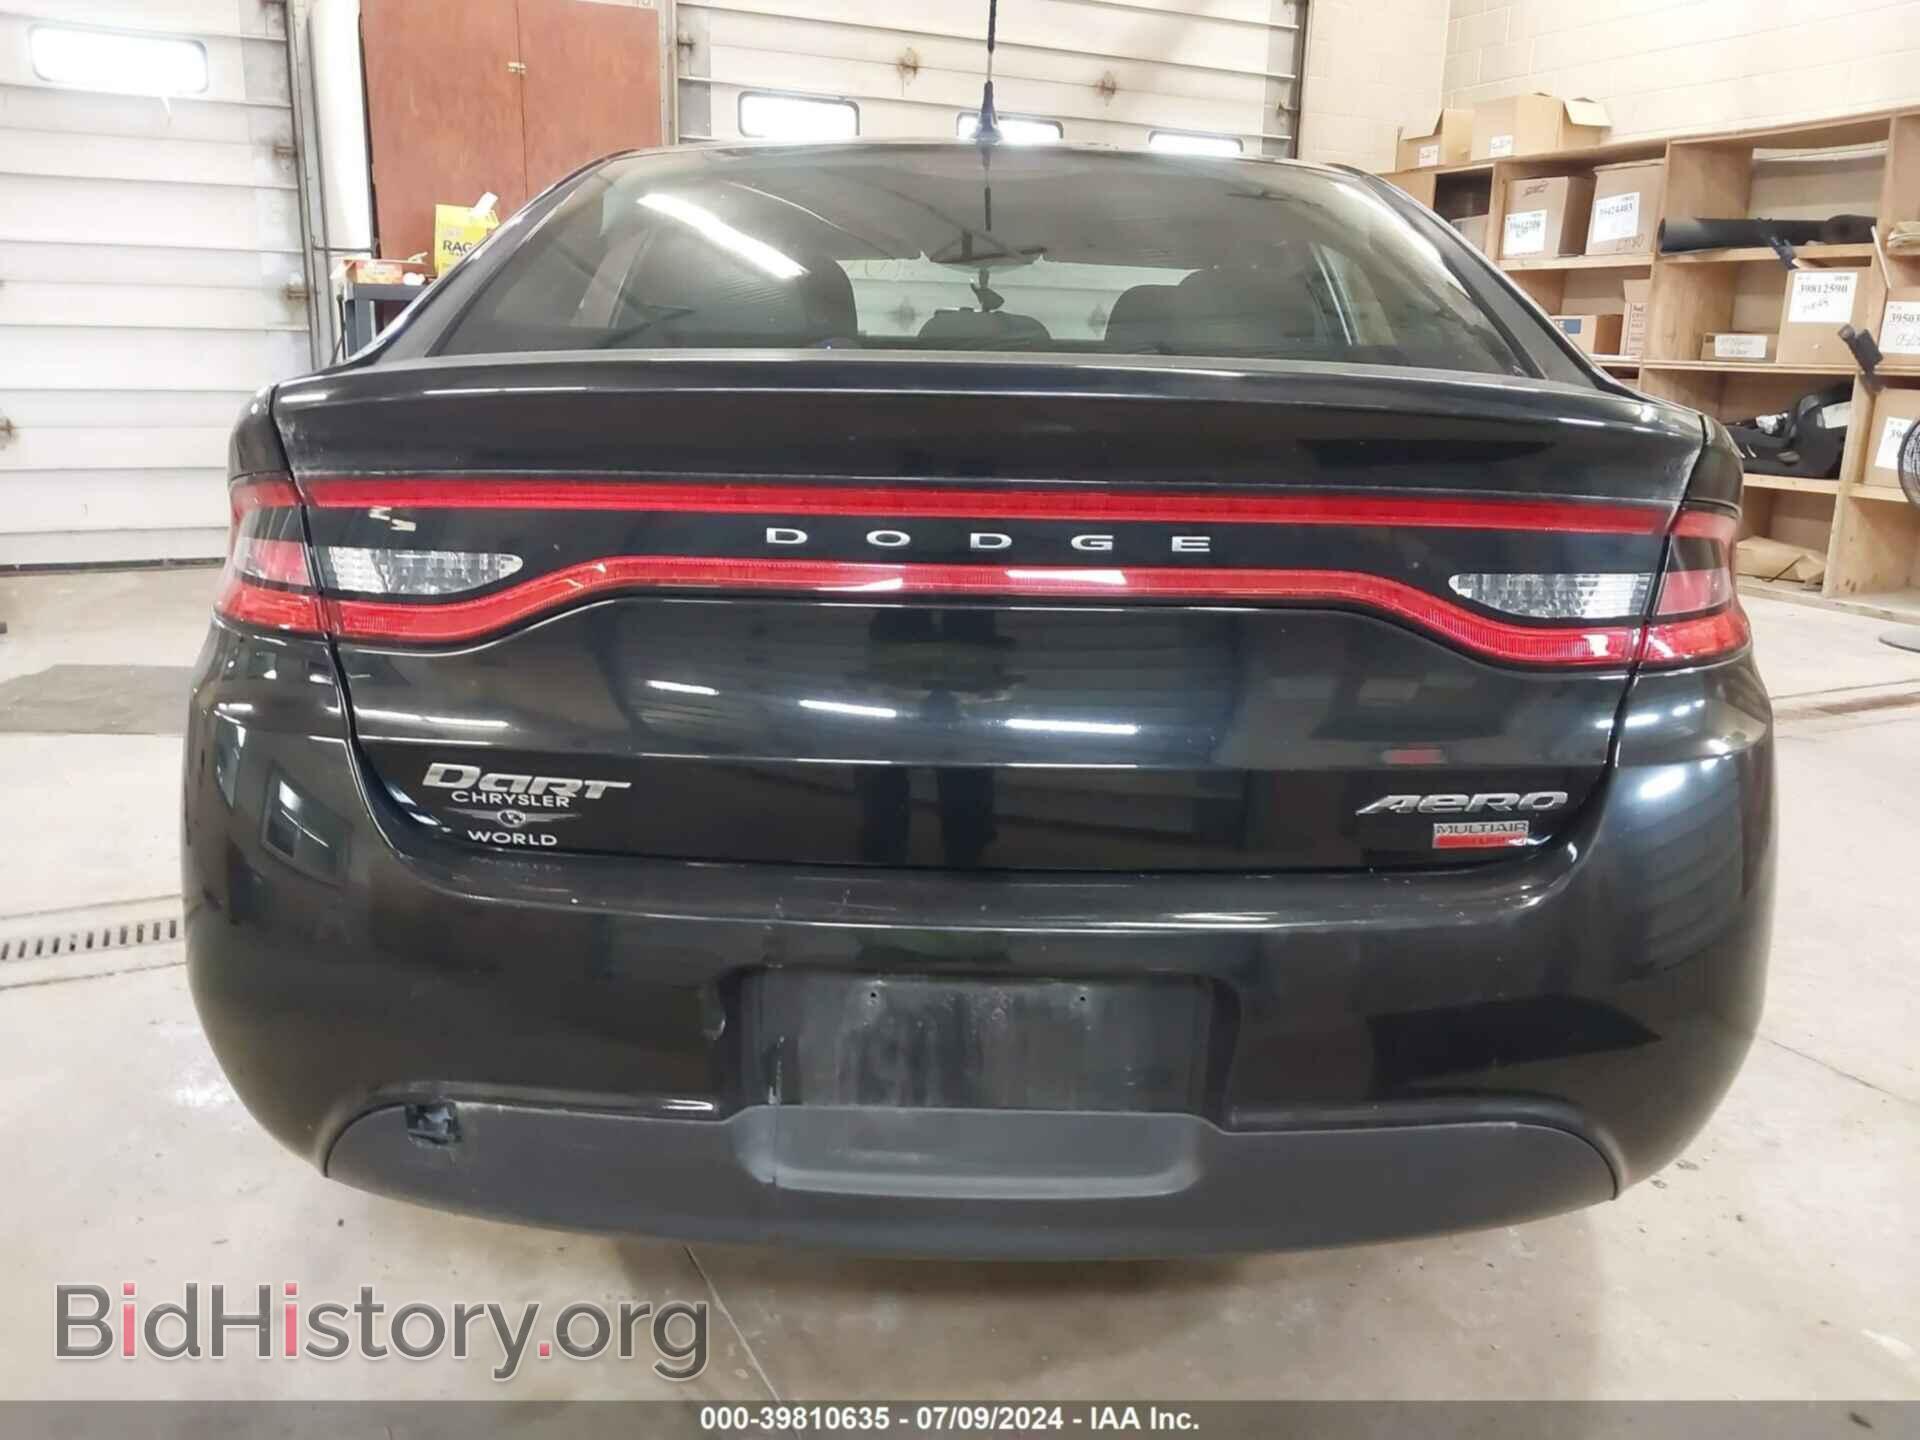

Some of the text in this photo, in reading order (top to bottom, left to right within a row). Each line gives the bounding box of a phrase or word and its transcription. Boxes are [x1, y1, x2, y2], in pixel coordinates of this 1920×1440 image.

[766, 527, 1211, 553] DODGE
[422, 763, 632, 799] DART
[451, 791, 570, 808] CHRYSLER
[1355, 791, 1568, 816] AERO
[467, 830, 558, 846] WORLD
[1436, 822, 1527, 834] MULTIAIR
